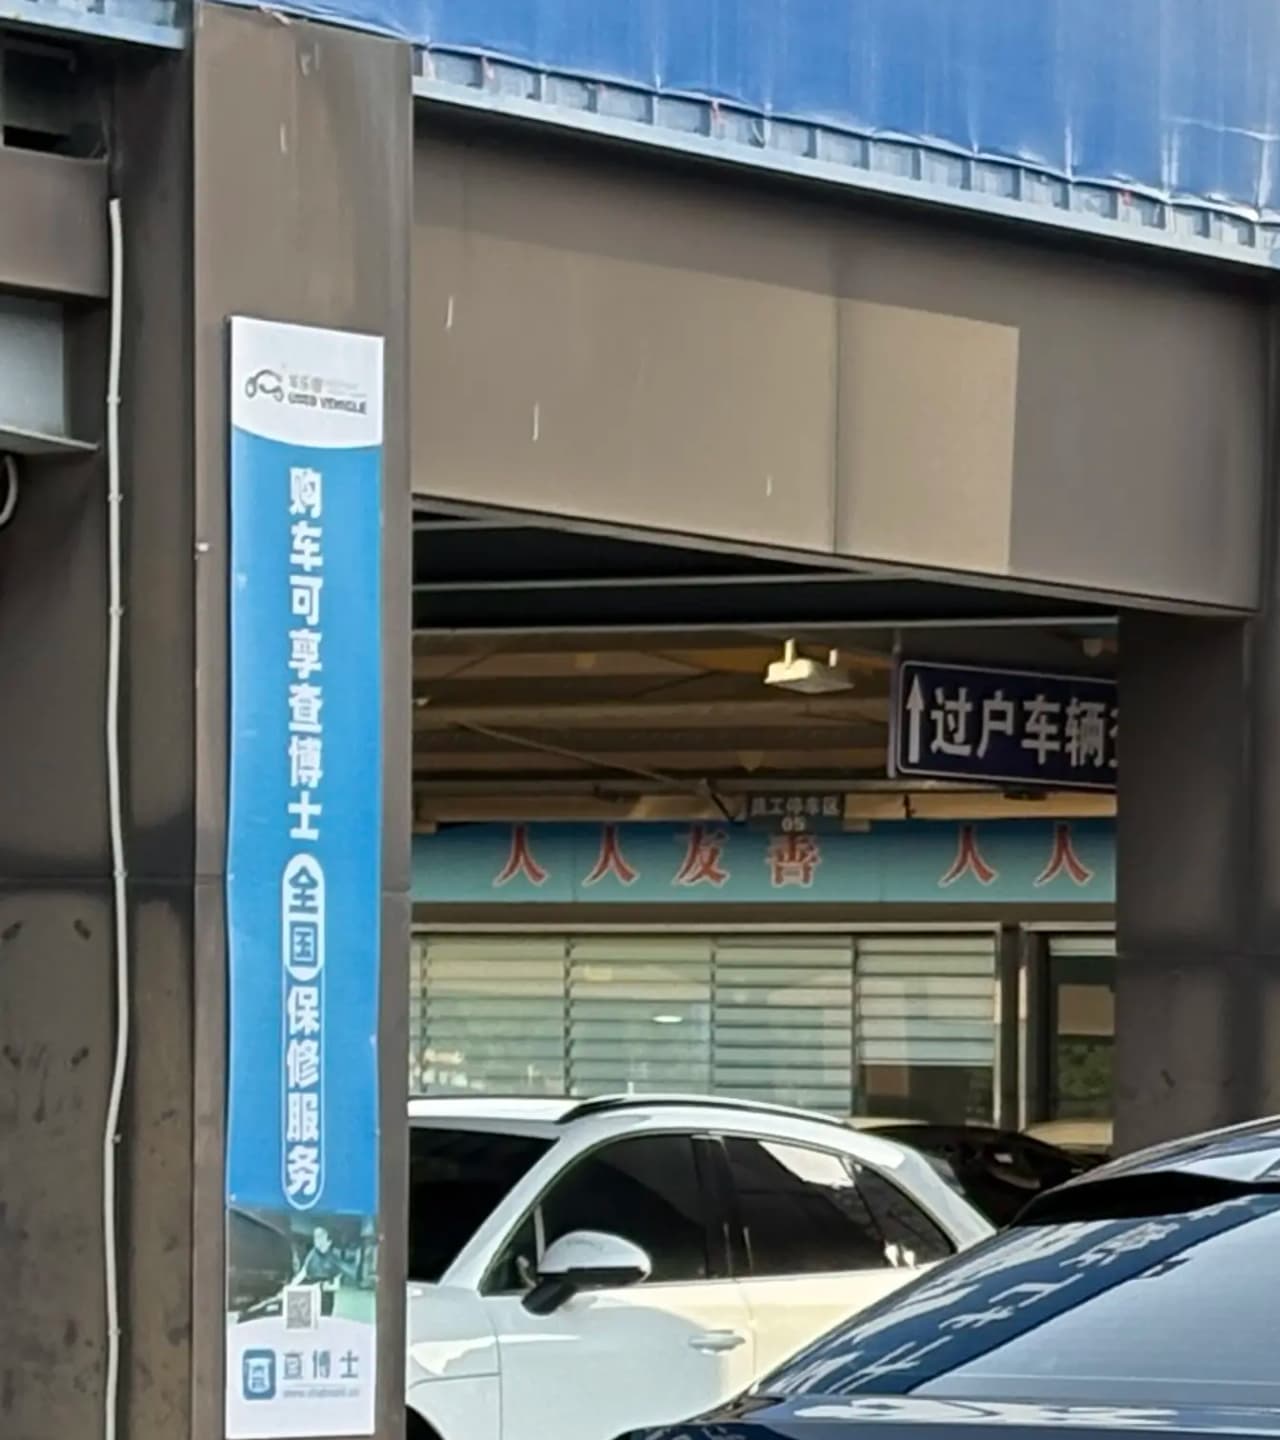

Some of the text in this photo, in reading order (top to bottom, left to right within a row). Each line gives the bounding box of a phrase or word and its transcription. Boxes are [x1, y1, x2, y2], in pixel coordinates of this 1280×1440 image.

[930, 687, 1118, 768] 过户车辆
[286, 467, 324, 1197] 购车可享查博士 全国保修服务
[492, 824, 822, 888] 人人友善
